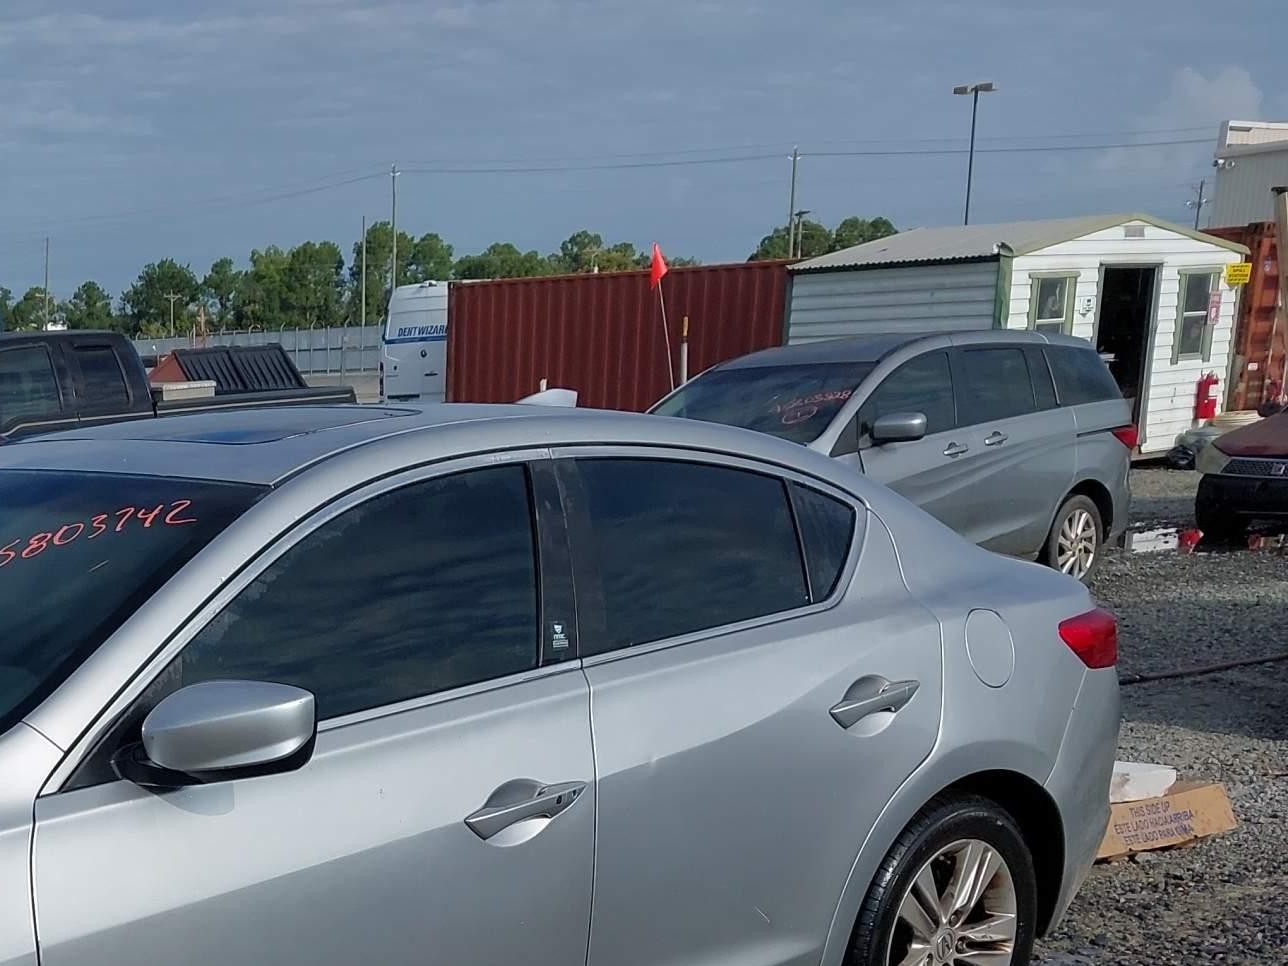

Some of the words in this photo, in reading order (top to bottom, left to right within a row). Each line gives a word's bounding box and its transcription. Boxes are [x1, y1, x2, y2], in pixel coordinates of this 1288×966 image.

[398, 326, 418, 338] DENT
[1128, 806, 1145, 818] THIS
[1145, 802, 1161, 815] SIDE
[1160, 800, 1170, 813] UP
[1113, 822, 1132, 835] ESTE
[1132, 818, 1150, 832] LADO
[1149, 814, 1168, 827] HACIA
[1168, 808, 1193, 825] ARRIBA
[1123, 833, 1142, 846] ESTE
[1142, 829, 1159, 843] LADO
[1158, 826, 1177, 840] PARA
